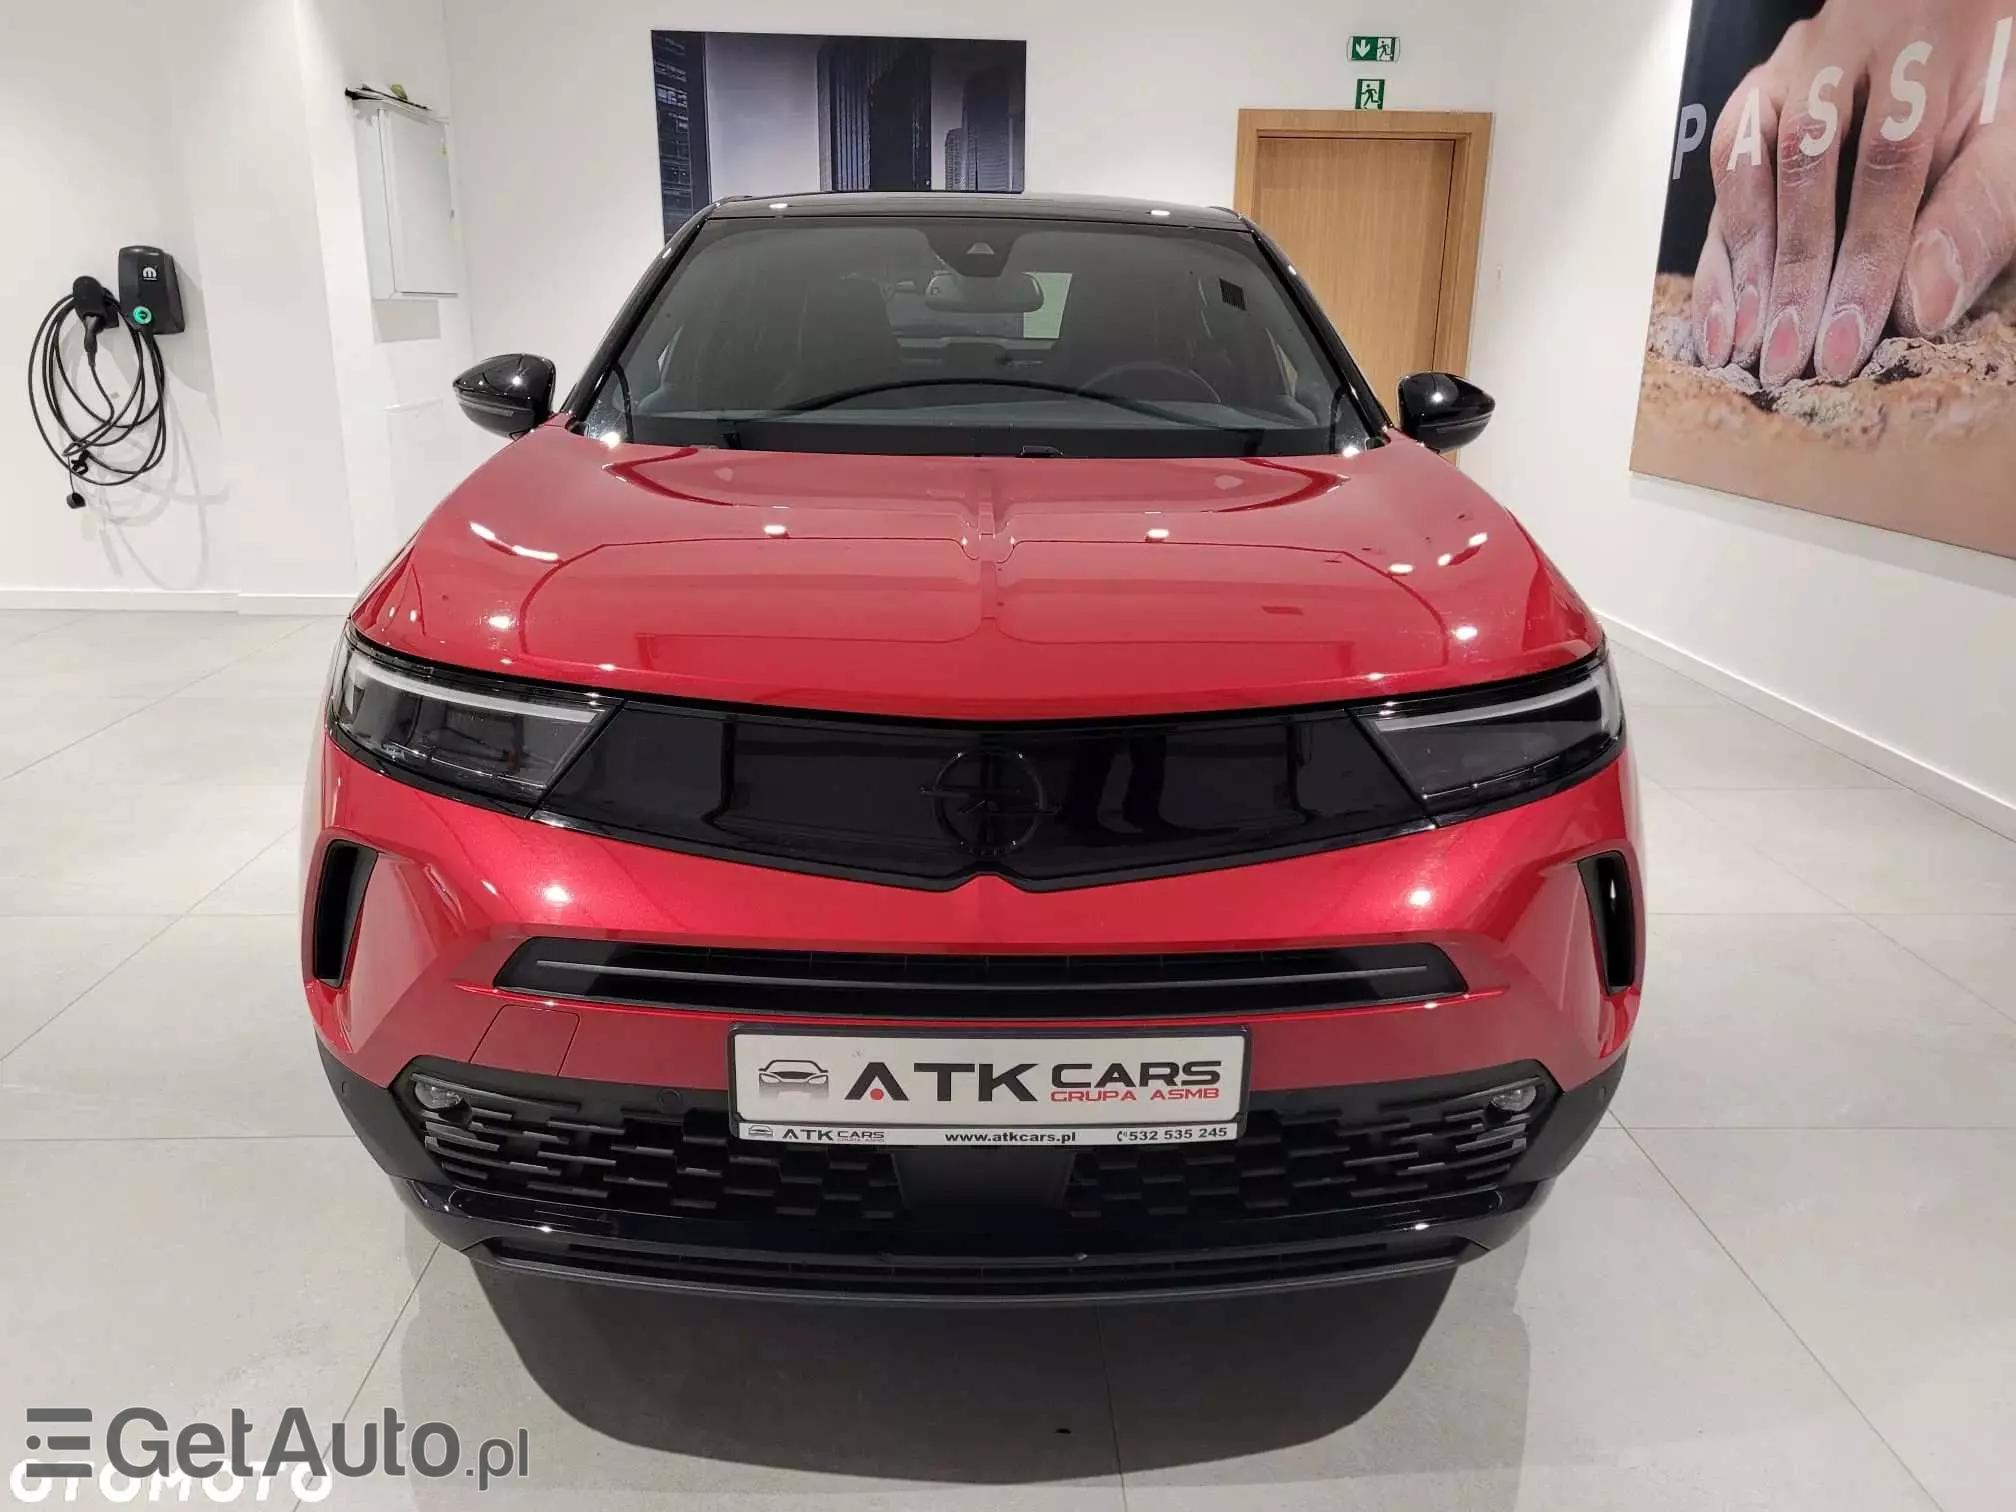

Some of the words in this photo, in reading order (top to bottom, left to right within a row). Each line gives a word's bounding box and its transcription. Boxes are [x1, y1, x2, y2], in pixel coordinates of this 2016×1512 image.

[844, 1062, 1039, 1102] ATK
[1051, 1060, 1222, 1088] CARS
[1050, 1090, 1137, 1102] GRUPA
[1150, 1087, 1220, 1101] ASMB
[782, 1128, 834, 1141] ATK
[837, 1130, 885, 1139] CARS
[945, 1131, 1076, 1144] www.atkcars.pl
[1129, 1130, 1158, 1141] 532
[1164, 1128, 1193, 1140] 535
[1198, 1127, 1228, 1138] 245
